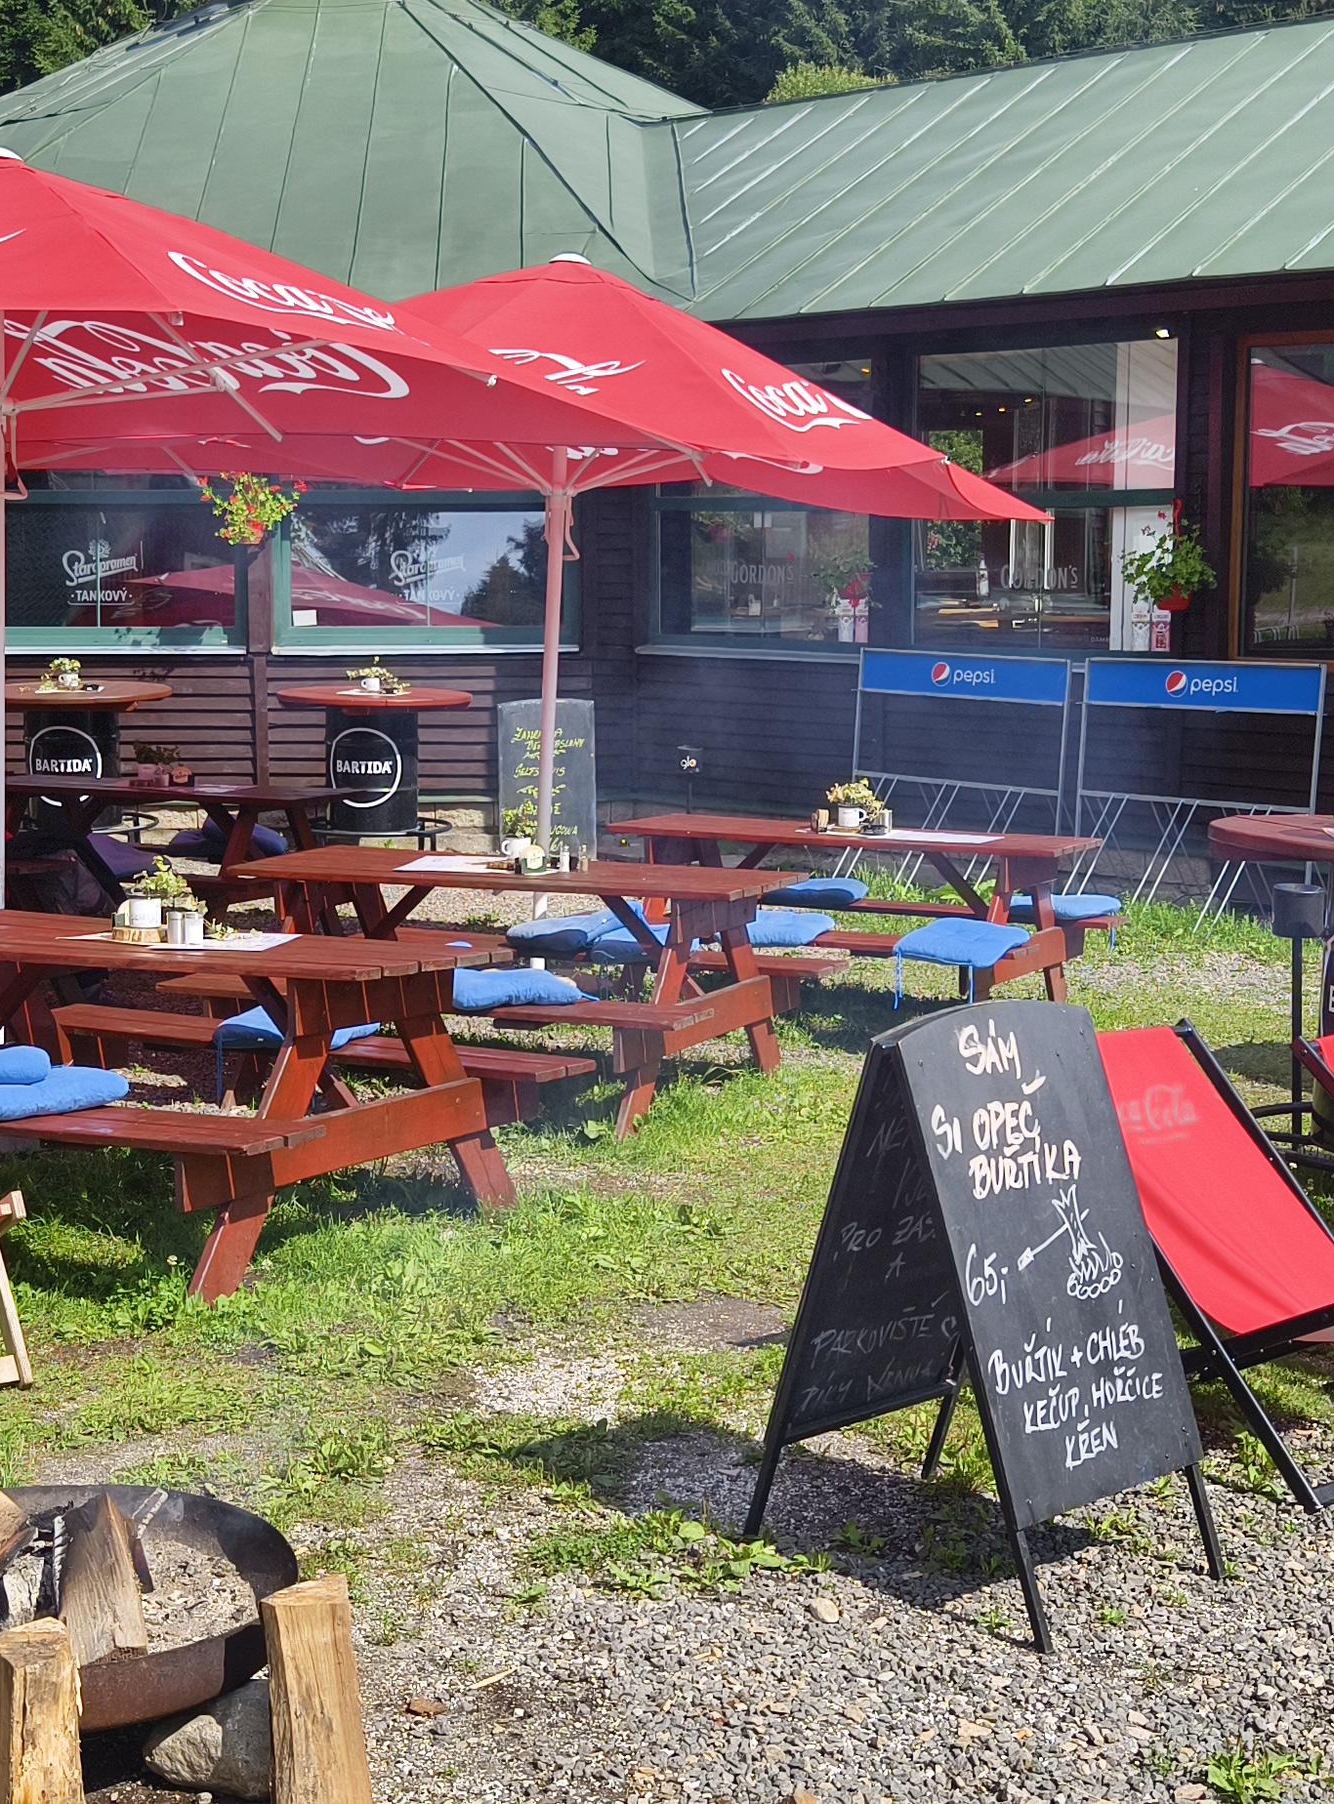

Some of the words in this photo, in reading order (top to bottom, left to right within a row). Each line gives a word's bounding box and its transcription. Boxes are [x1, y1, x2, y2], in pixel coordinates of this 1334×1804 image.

[953, 668, 995, 685] pepsi
[1190, 675, 1237, 693] pepsi
[35, 758, 93, 773] BARTIDA
[336, 759, 394, 774] BARTIDA
[959, 1019, 1021, 1079] SÁM
[931, 1105, 962, 1160] SI
[1065, 1419, 1117, 1470] KŘEN
